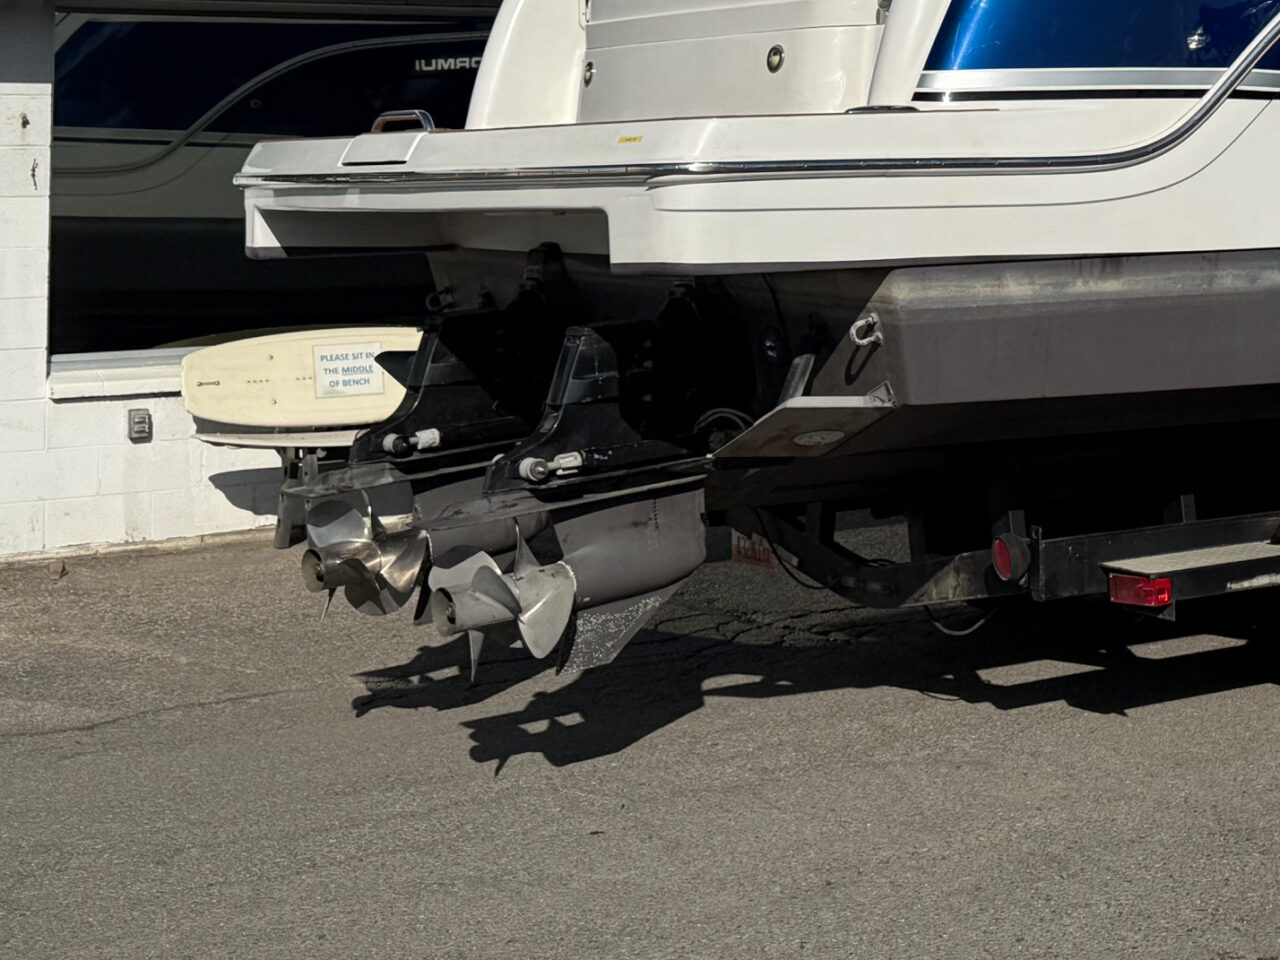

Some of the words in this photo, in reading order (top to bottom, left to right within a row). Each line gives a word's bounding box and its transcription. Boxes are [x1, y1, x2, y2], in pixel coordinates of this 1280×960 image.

[320, 353, 349, 362] PLEASE
[352, 352, 364, 360] SIT
[342, 365, 373, 375] MIDDLE
[329, 380, 340, 388] OF
[342, 378, 370, 387] BENCH
